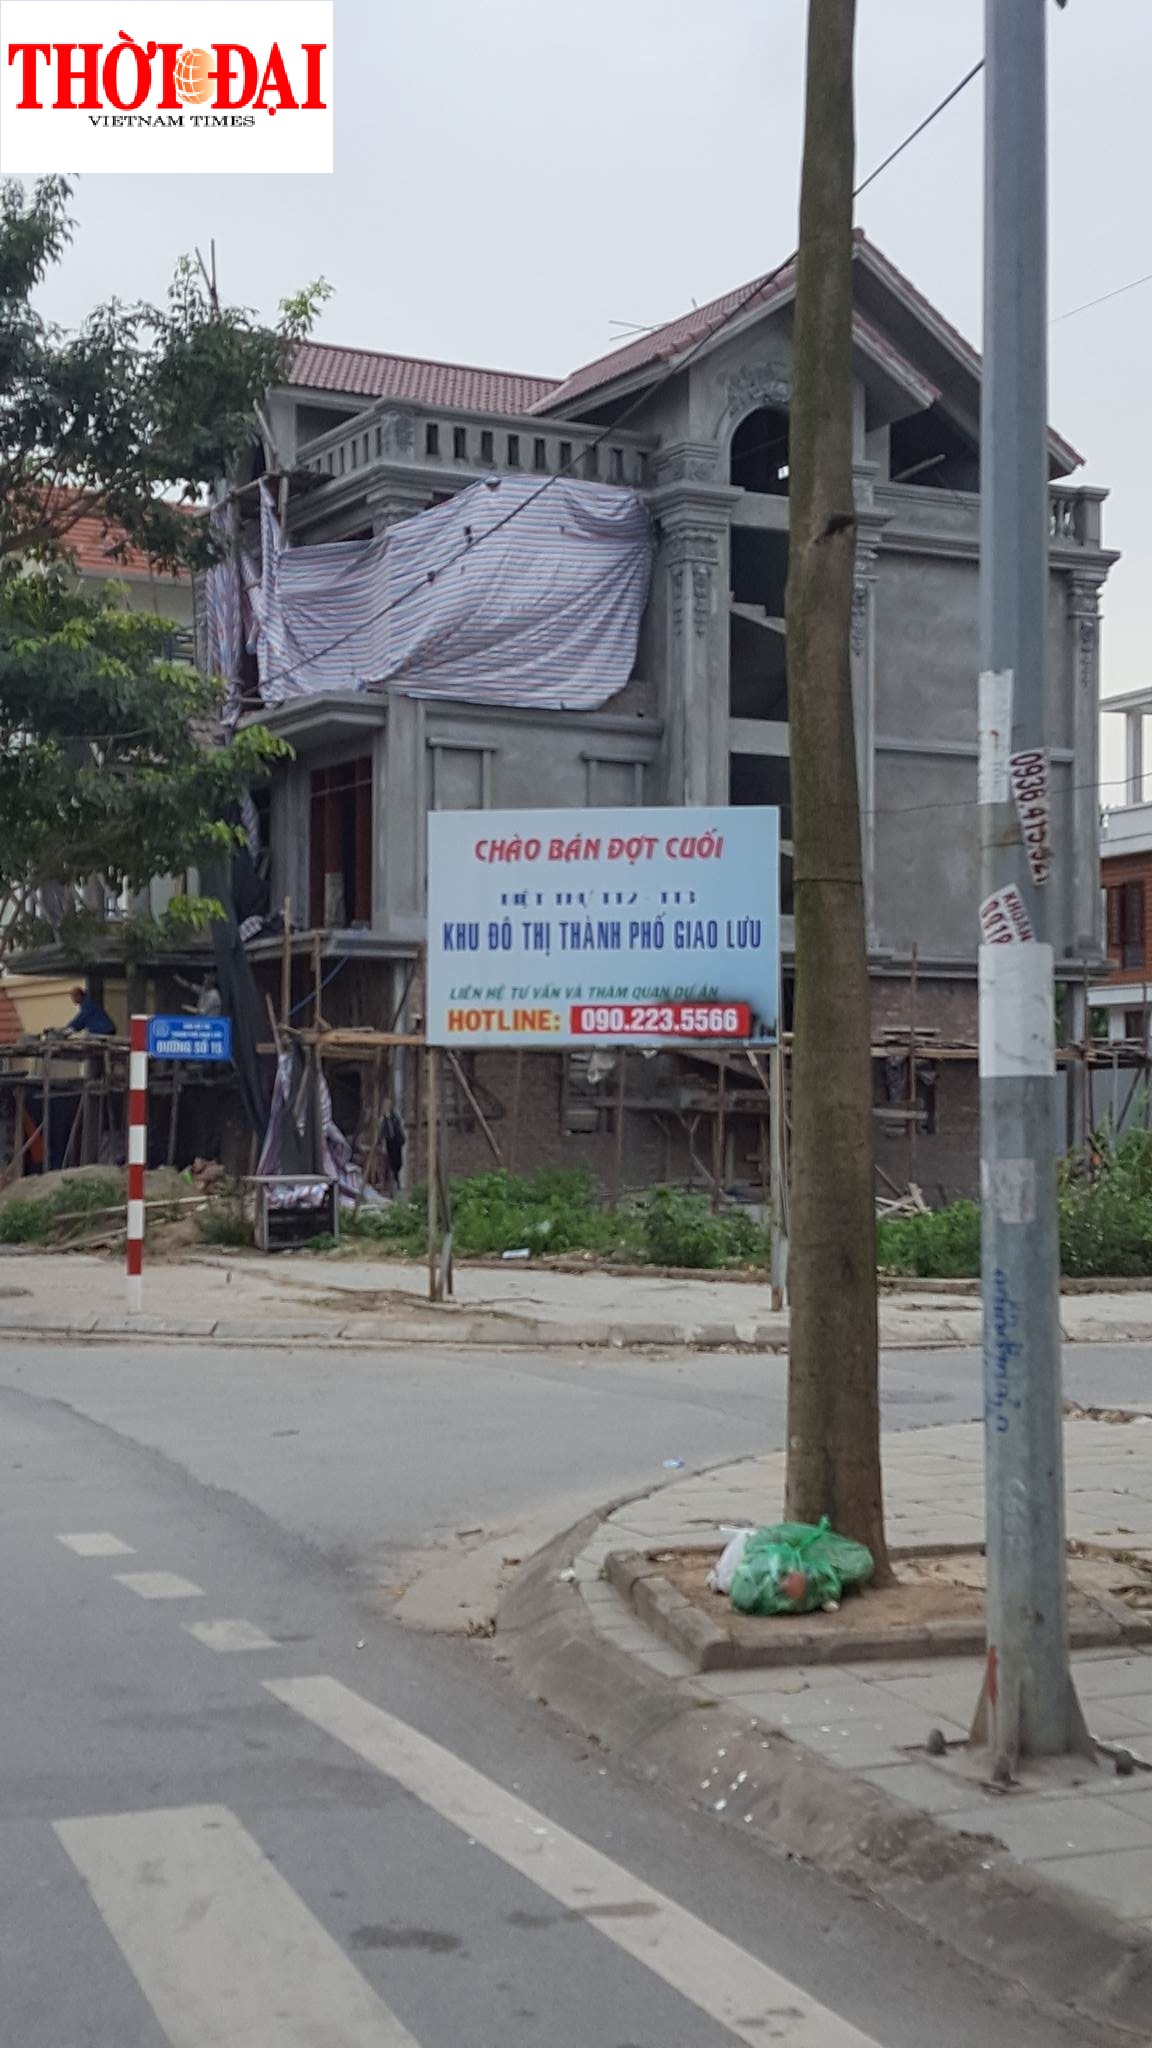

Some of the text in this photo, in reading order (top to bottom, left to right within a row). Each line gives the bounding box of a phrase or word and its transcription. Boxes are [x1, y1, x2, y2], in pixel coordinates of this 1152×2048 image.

[475, 828, 724, 866] CHÀO BÁN ĐỢT CUỐI
[443, 911, 761, 956] KHU ĐÔ THỊ THÀNH PHỐ GIAO LƯU
[631, 986, 671, 1000] QUAN
[447, 1009, 560, 1032] HOTLINE:
[581, 1007, 738, 1033] 090.223.5566
